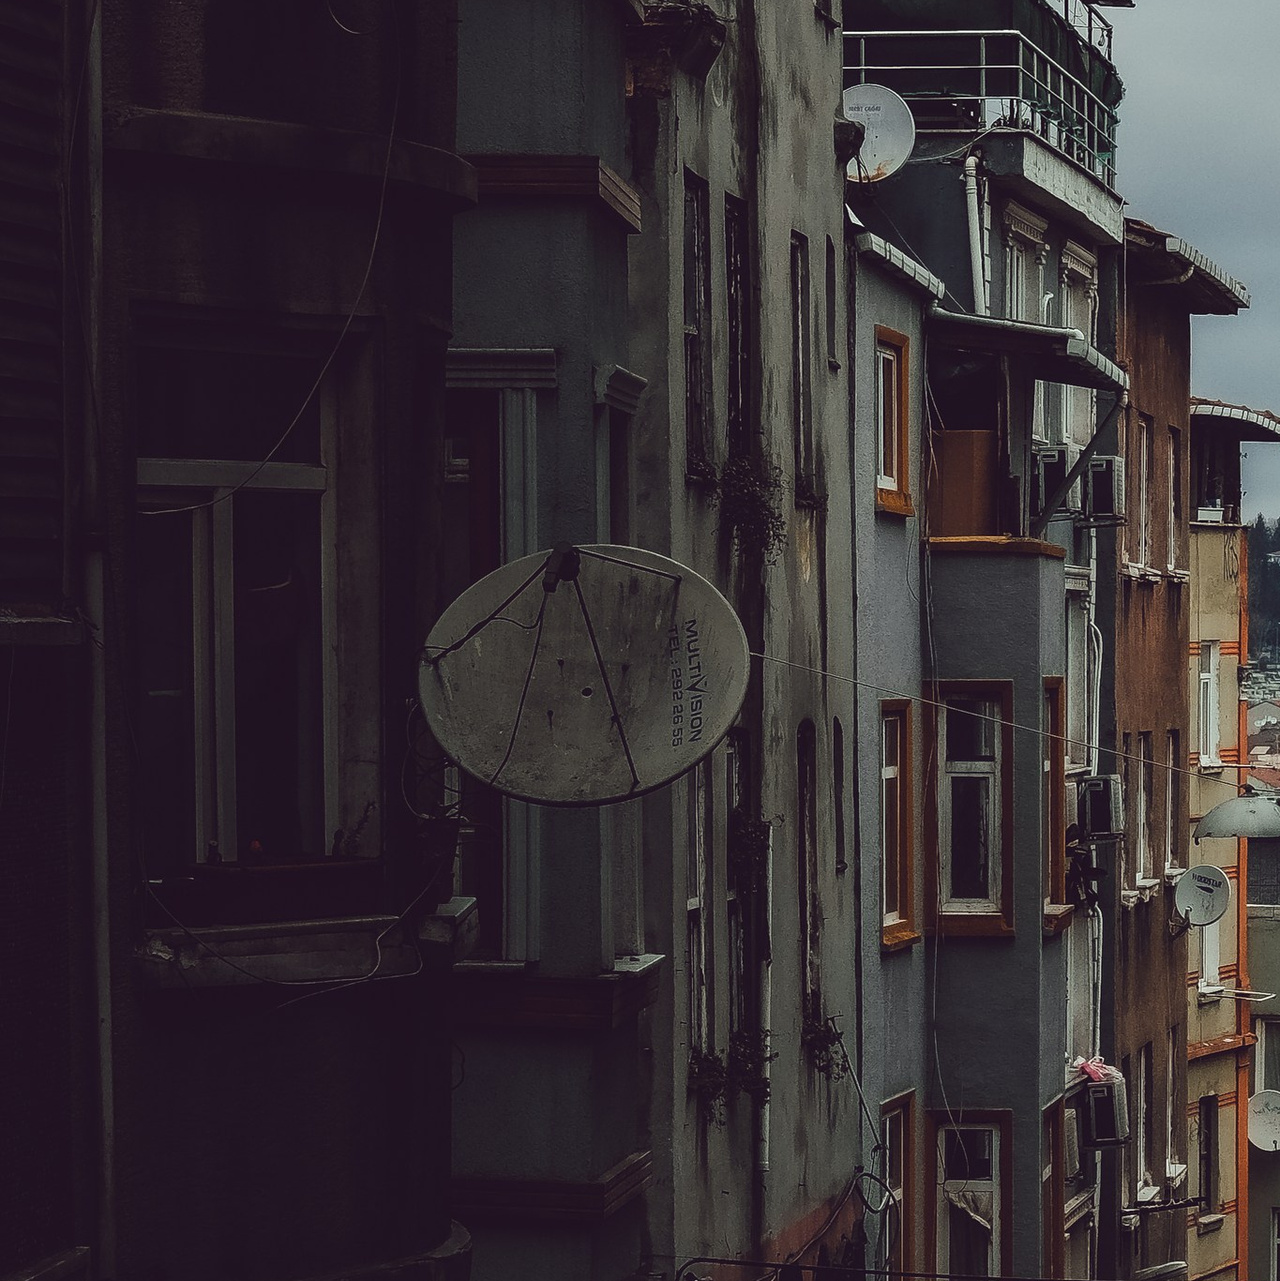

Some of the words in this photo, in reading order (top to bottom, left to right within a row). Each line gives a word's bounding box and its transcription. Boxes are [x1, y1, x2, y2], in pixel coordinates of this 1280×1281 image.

[671, 667, 684, 702] 292
[684, 618, 709, 743] MULTIVISION
[672, 704, 684, 725] 26
[672, 728, 684, 747] 55
[1192, 873, 1222, 888] WOODSTAR
